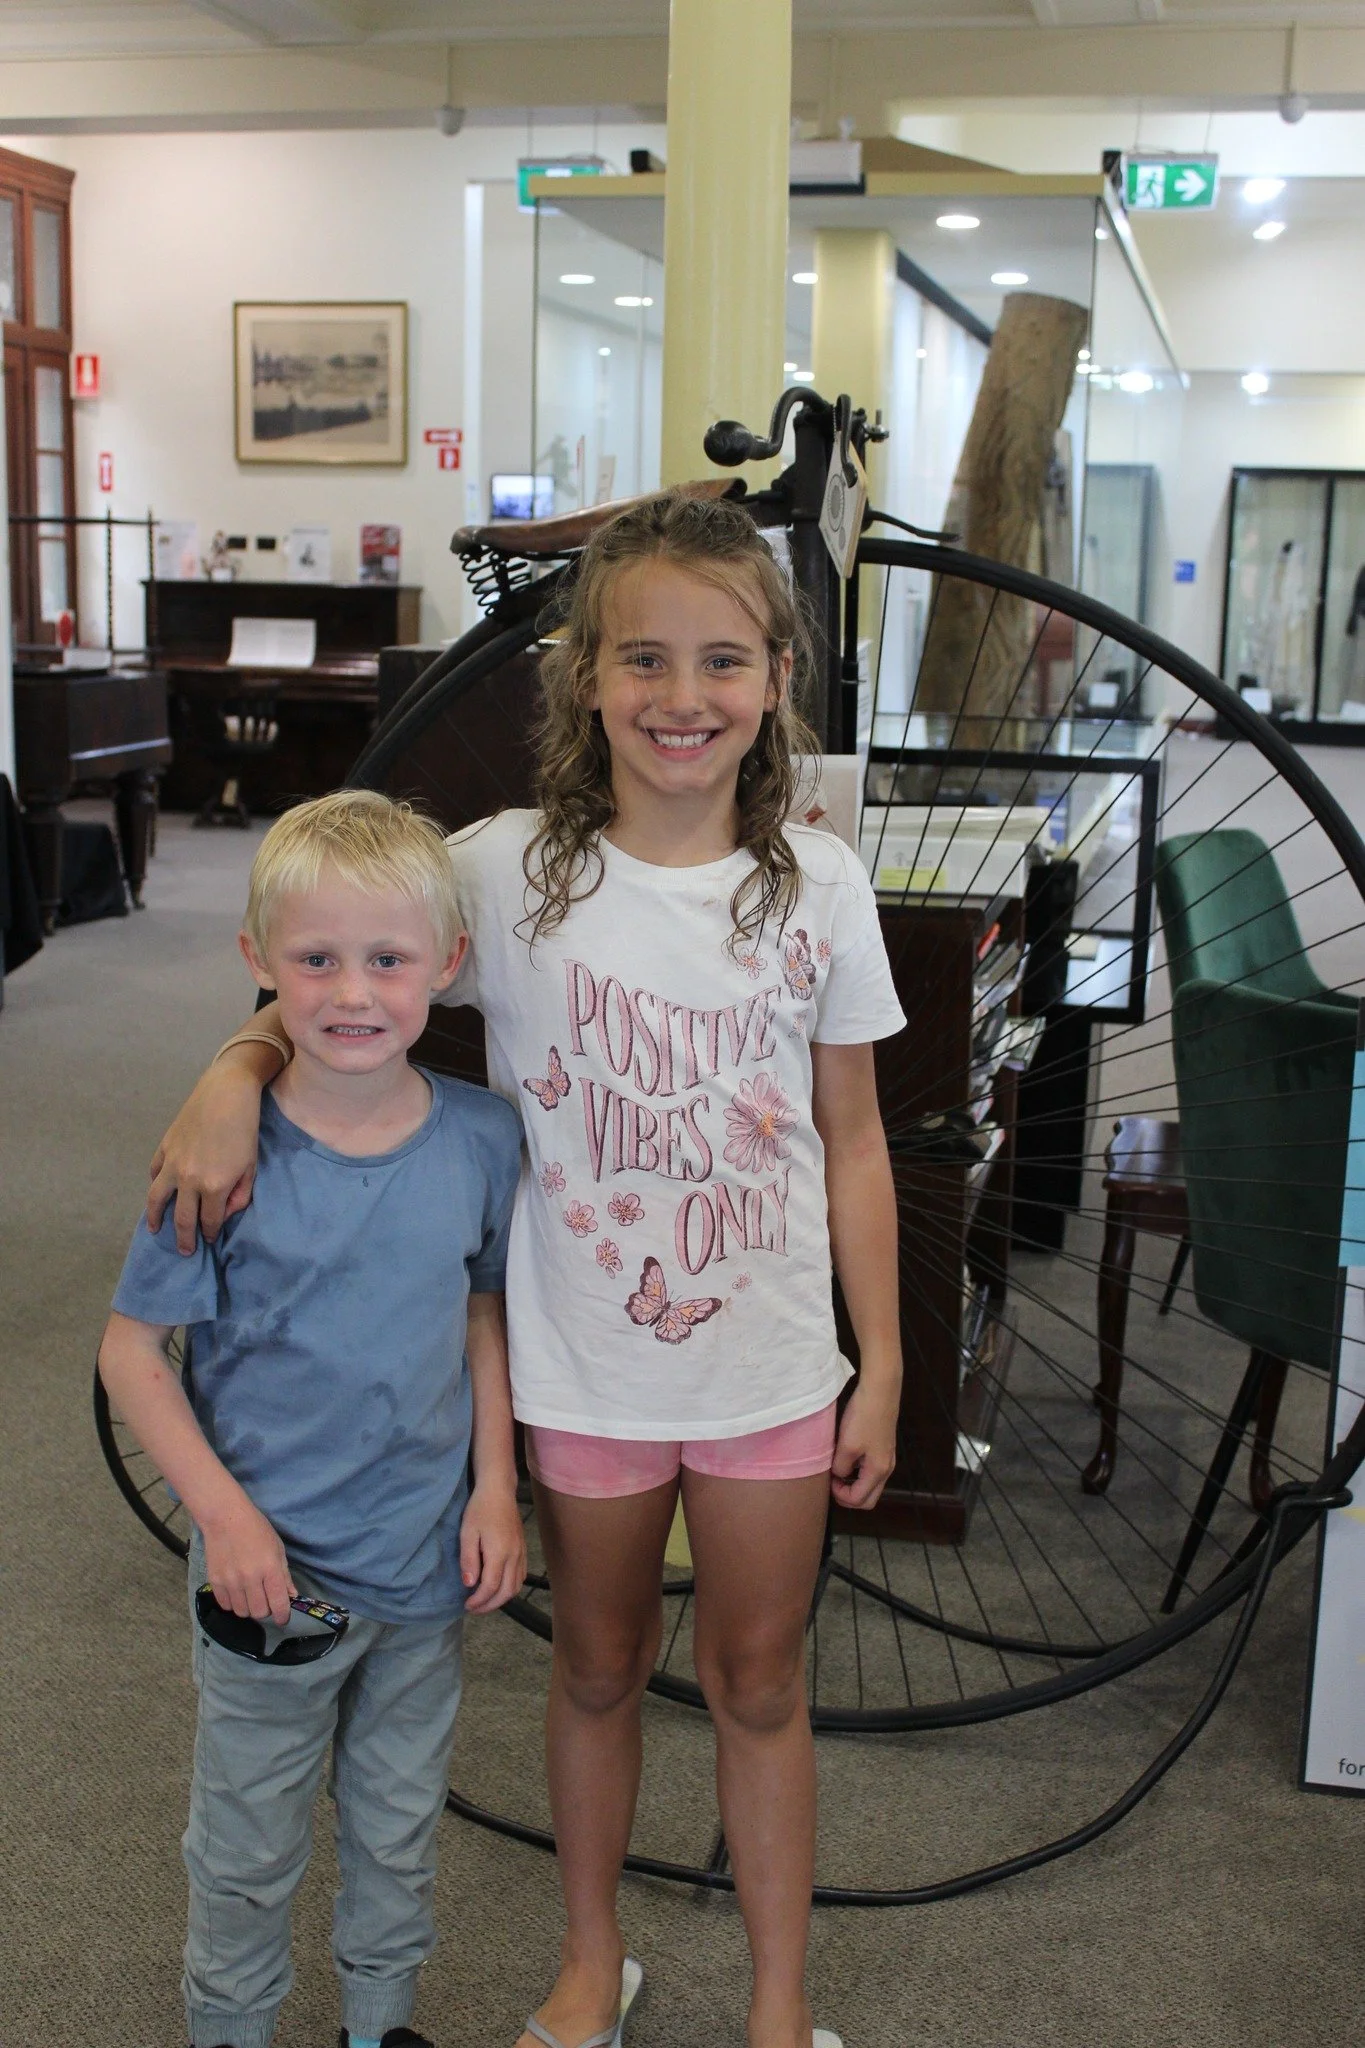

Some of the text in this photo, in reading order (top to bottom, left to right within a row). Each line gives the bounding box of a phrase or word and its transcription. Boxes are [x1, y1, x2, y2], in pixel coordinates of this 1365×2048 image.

[563, 959, 782, 1097] POSITIVE
[578, 1077, 713, 1183] VIBES
[674, 1164, 791, 1275] ONLY
